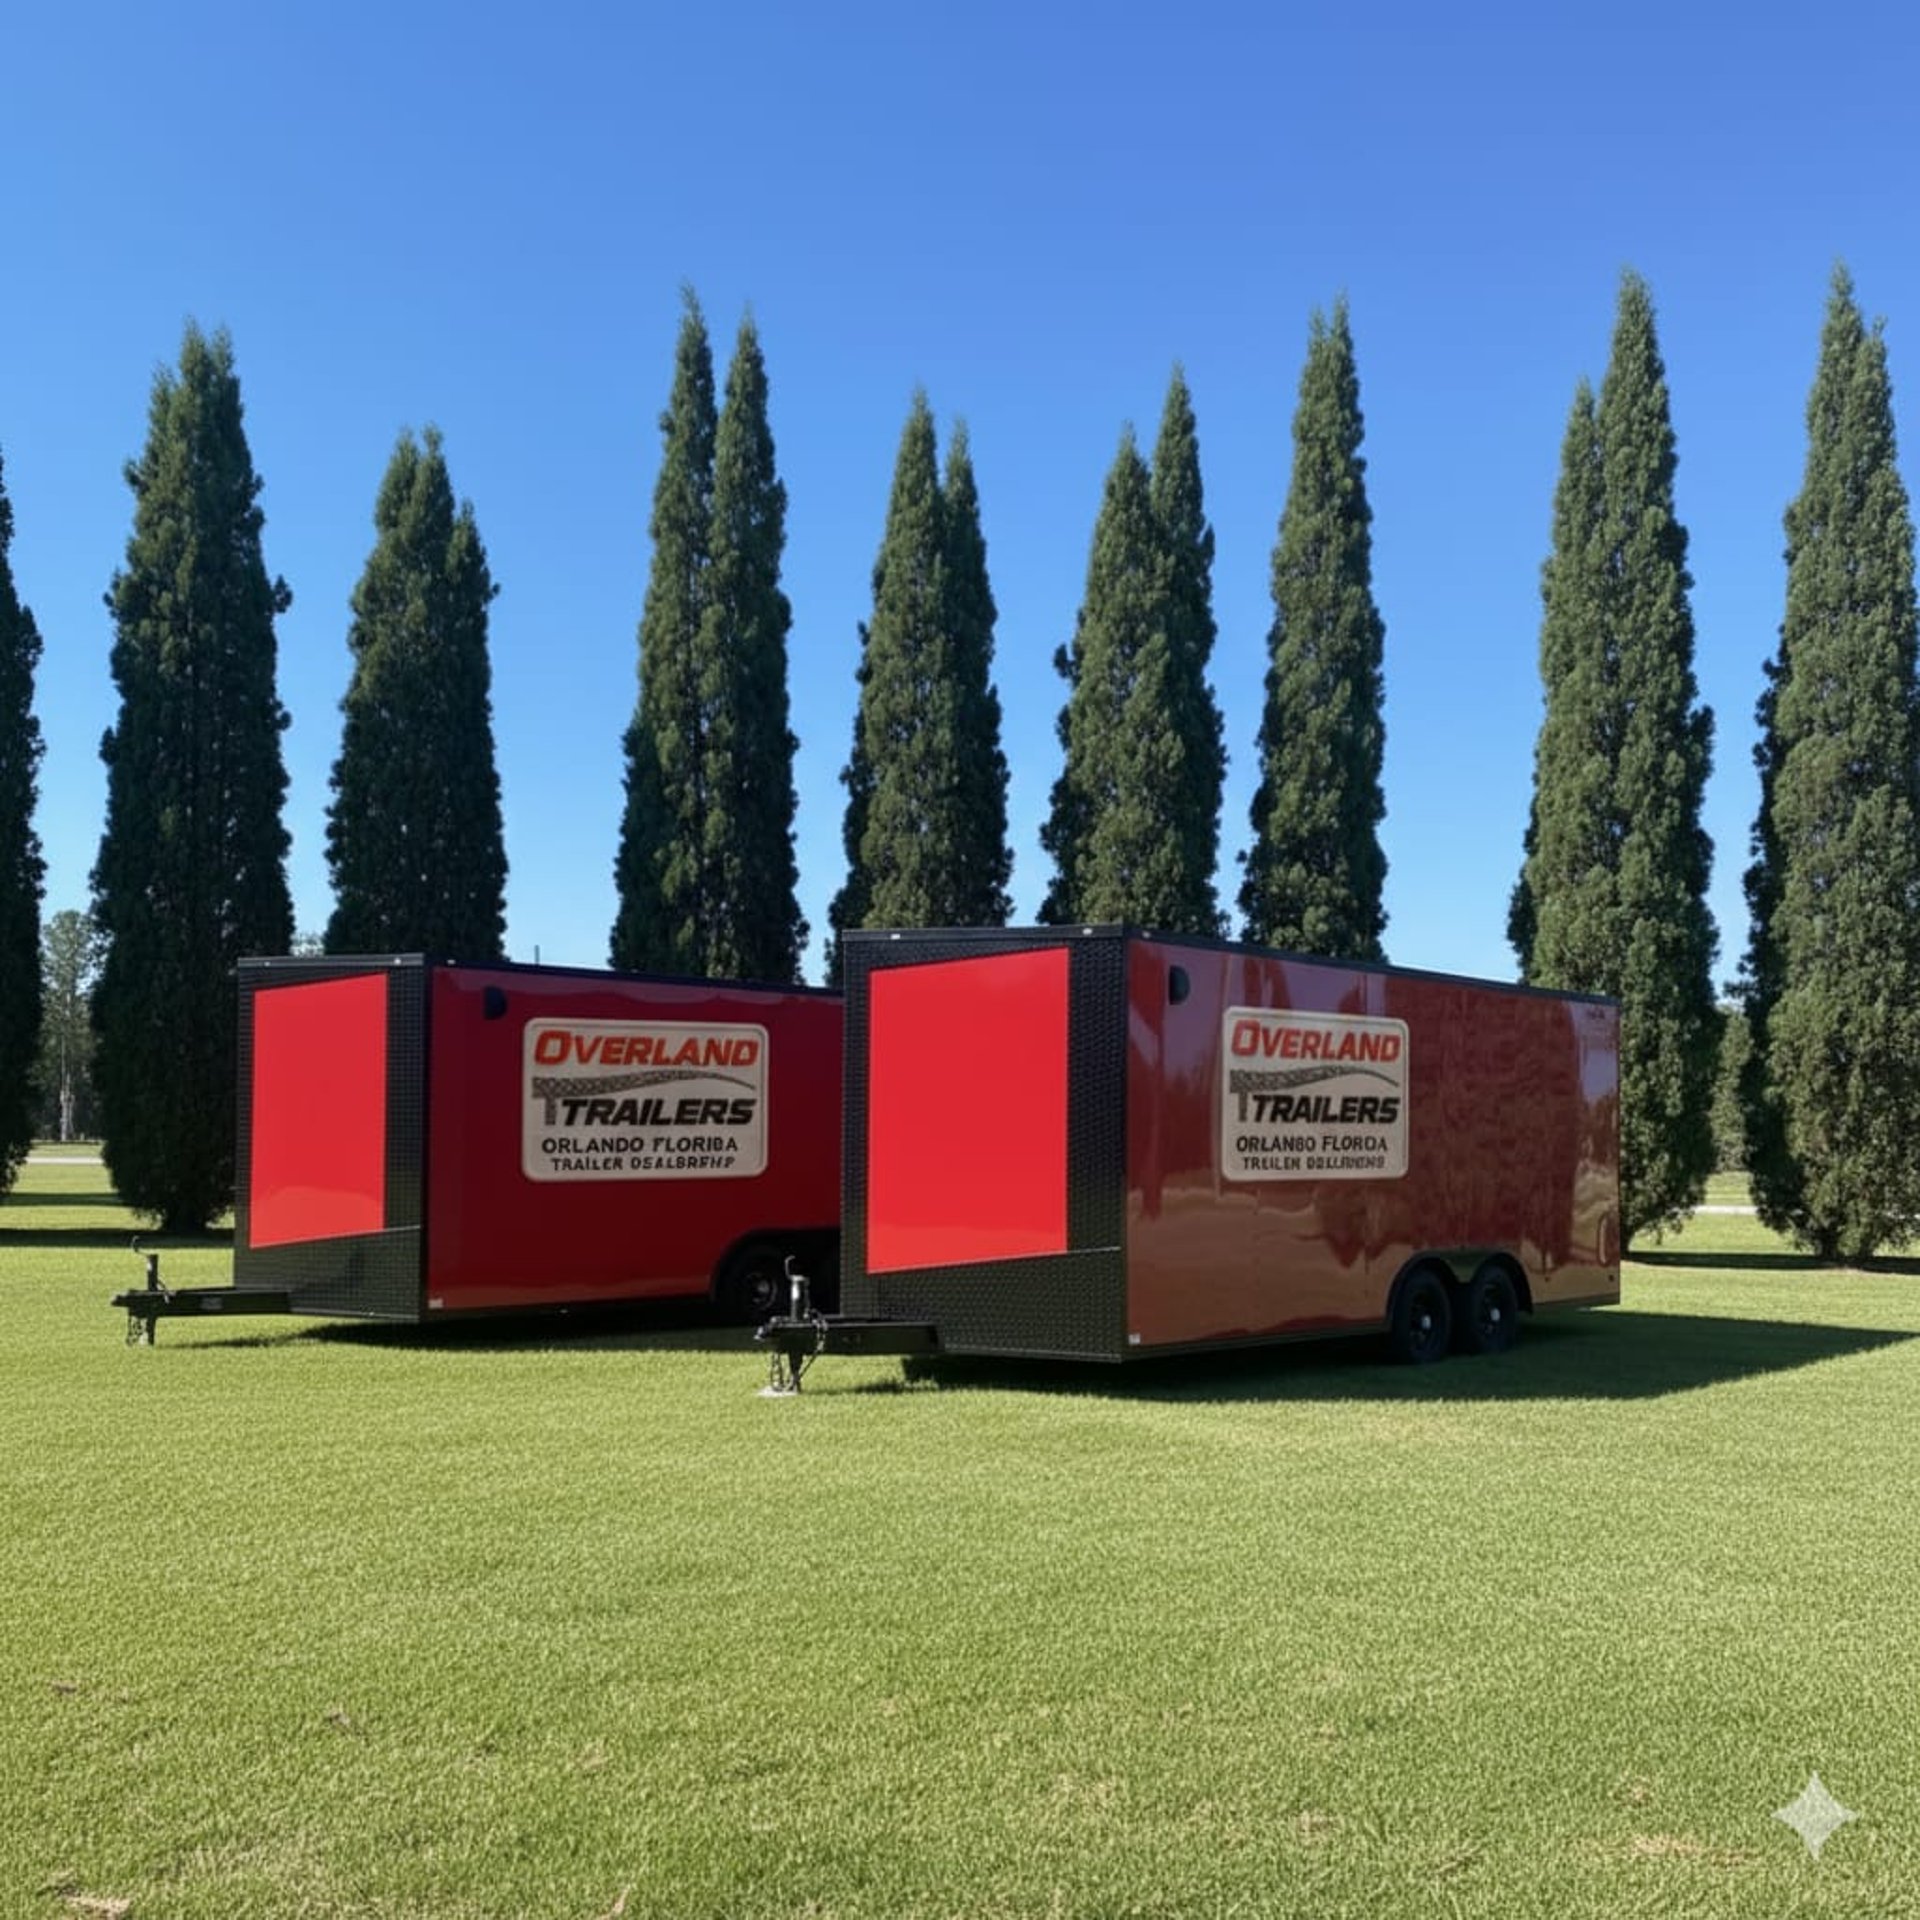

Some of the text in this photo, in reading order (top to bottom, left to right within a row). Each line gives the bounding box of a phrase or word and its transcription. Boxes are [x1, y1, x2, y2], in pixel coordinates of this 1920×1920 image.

[534, 1030, 759, 1066] OVERLAND
[1232, 1019, 1401, 1063] OVERLAND
[541, 1137, 645, 1153] ORLANDO
